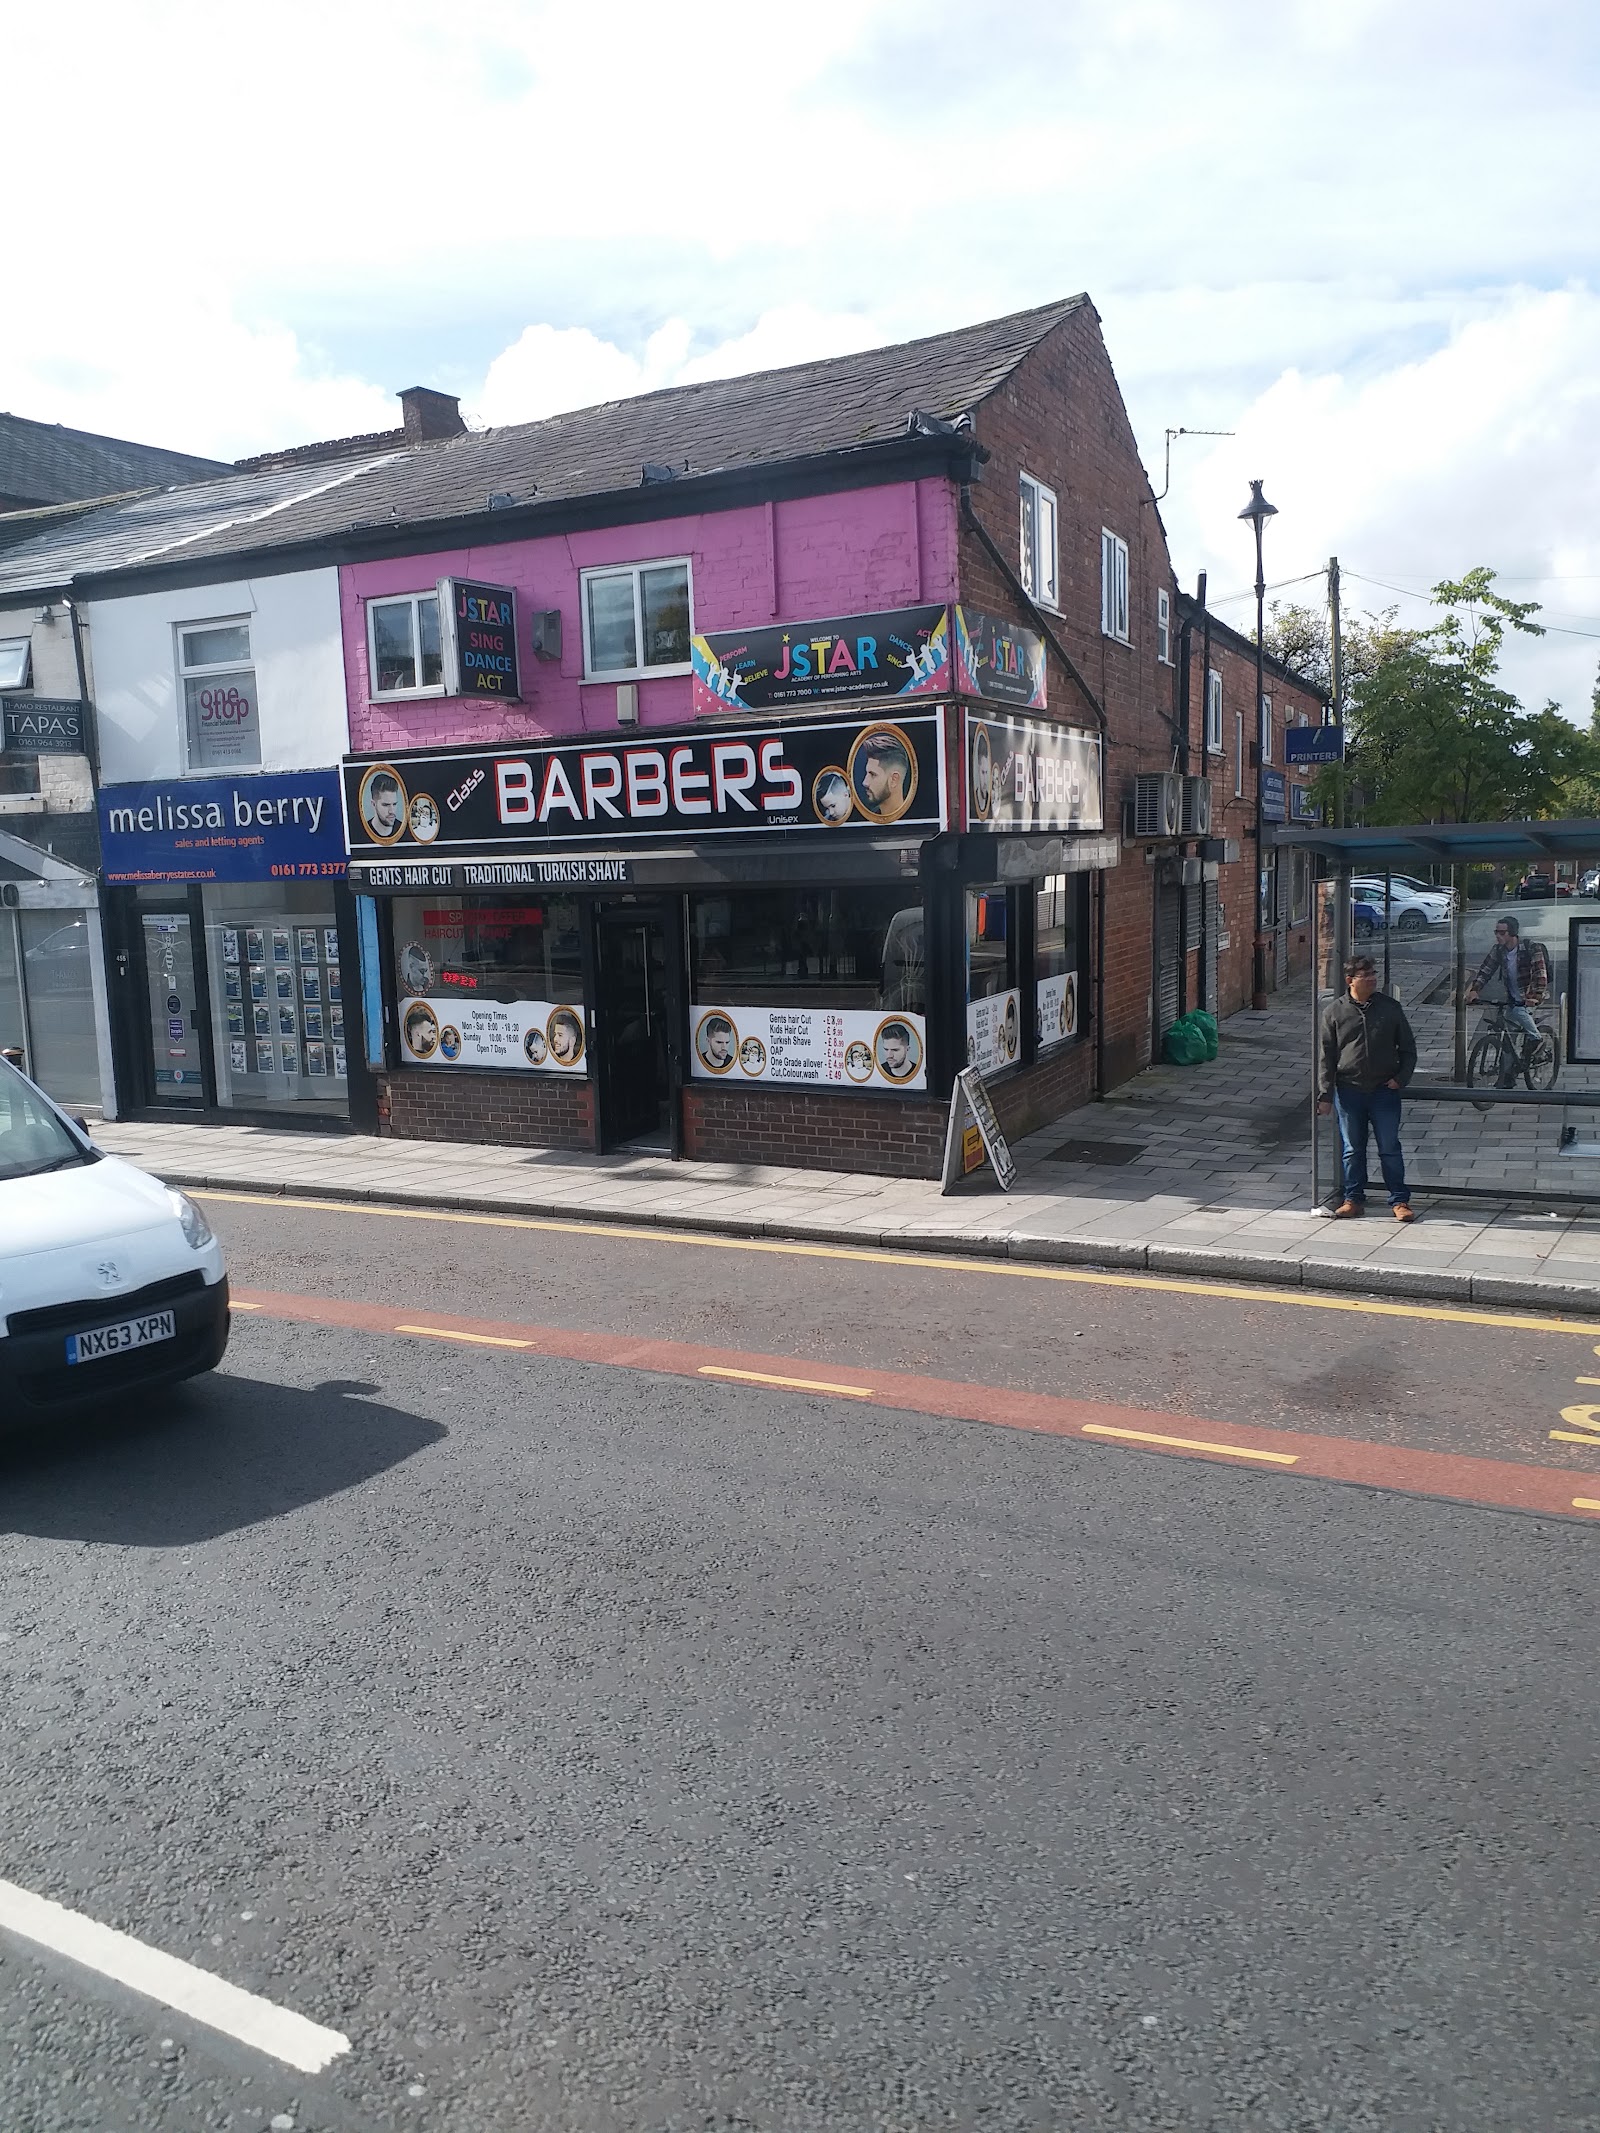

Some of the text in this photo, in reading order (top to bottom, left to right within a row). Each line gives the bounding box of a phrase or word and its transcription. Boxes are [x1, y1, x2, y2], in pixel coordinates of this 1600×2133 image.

[916, 629, 932, 638] ACT
[470, 632, 504, 651] SING
[888, 634, 912, 652] DANCE
[720, 646, 748, 662] PERFORM
[886, 654, 902, 668] SING
[464, 652, 512, 672] DANCE
[736, 660, 756, 670] LEARN
[477, 673, 504, 690] ACT
[744, 668, 768, 683] BELIEVE
[821, 672, 849, 680] PERFORMING
[797, 688, 812, 696] 7000
[821, 680, 888, 694] www.jstar-academy.co.uk
[200, 687, 238, 708] one
[34, 704, 80, 712] RESTAURANT
[6, 714, 79, 736] TAPAS
[18, 738, 36, 746] 0161
[1290, 752, 1338, 762] PRINTERS
[494, 738, 803, 825] BARBERS
[1014, 752, 1080, 804] BARBERS
[446, 766, 486, 812] Class
[109, 790, 324, 834] melissa berry
[768, 814, 799, 825] Unisex
[175, 835, 264, 849] sales and letting agents
[108, 868, 216, 882] www.melissaberryestates.co.uk
[271, 864, 295, 876] 0161
[299, 863, 318, 876] 773
[320, 862, 346, 874] 3377
[369, 867, 402, 886] GENTS
[404, 868, 429, 886] HAIR
[432, 866, 452, 885] CUT
[464, 863, 535, 884] TRADITIONAL
[537, 862, 587, 883] TURKISH
[588, 860, 626, 882] SHAVE
[424, 928, 464, 938] HAIRCUT
[442, 972, 478, 988] OPEN
[472, 1010, 508, 1021] Opening Times
[769, 1014, 786, 1023] Gents
[788, 1014, 800, 1024] hair
[801, 1014, 812, 1024] Cut
[462, 1022, 472, 1030] Mon
[476, 1022, 484, 1030] Sat
[770, 1024, 783, 1034] Kids
[785, 1025, 796, 1034] Hair
[798, 1026, 808, 1035] Cut
[464, 1032, 481, 1043] Sunday
[770, 1035, 791, 1045] Turkish
[793, 1036, 812, 1046] Shave
[477, 1044, 489, 1054] Open
[495, 1044, 507, 1055] Days
[770, 1046, 784, 1055] OAP
[771, 1056, 782, 1066] One
[784, 1057, 802, 1067] Grade
[803, 1058, 823, 1068] allover
[80, 1314, 172, 1357] NX63 XPN
